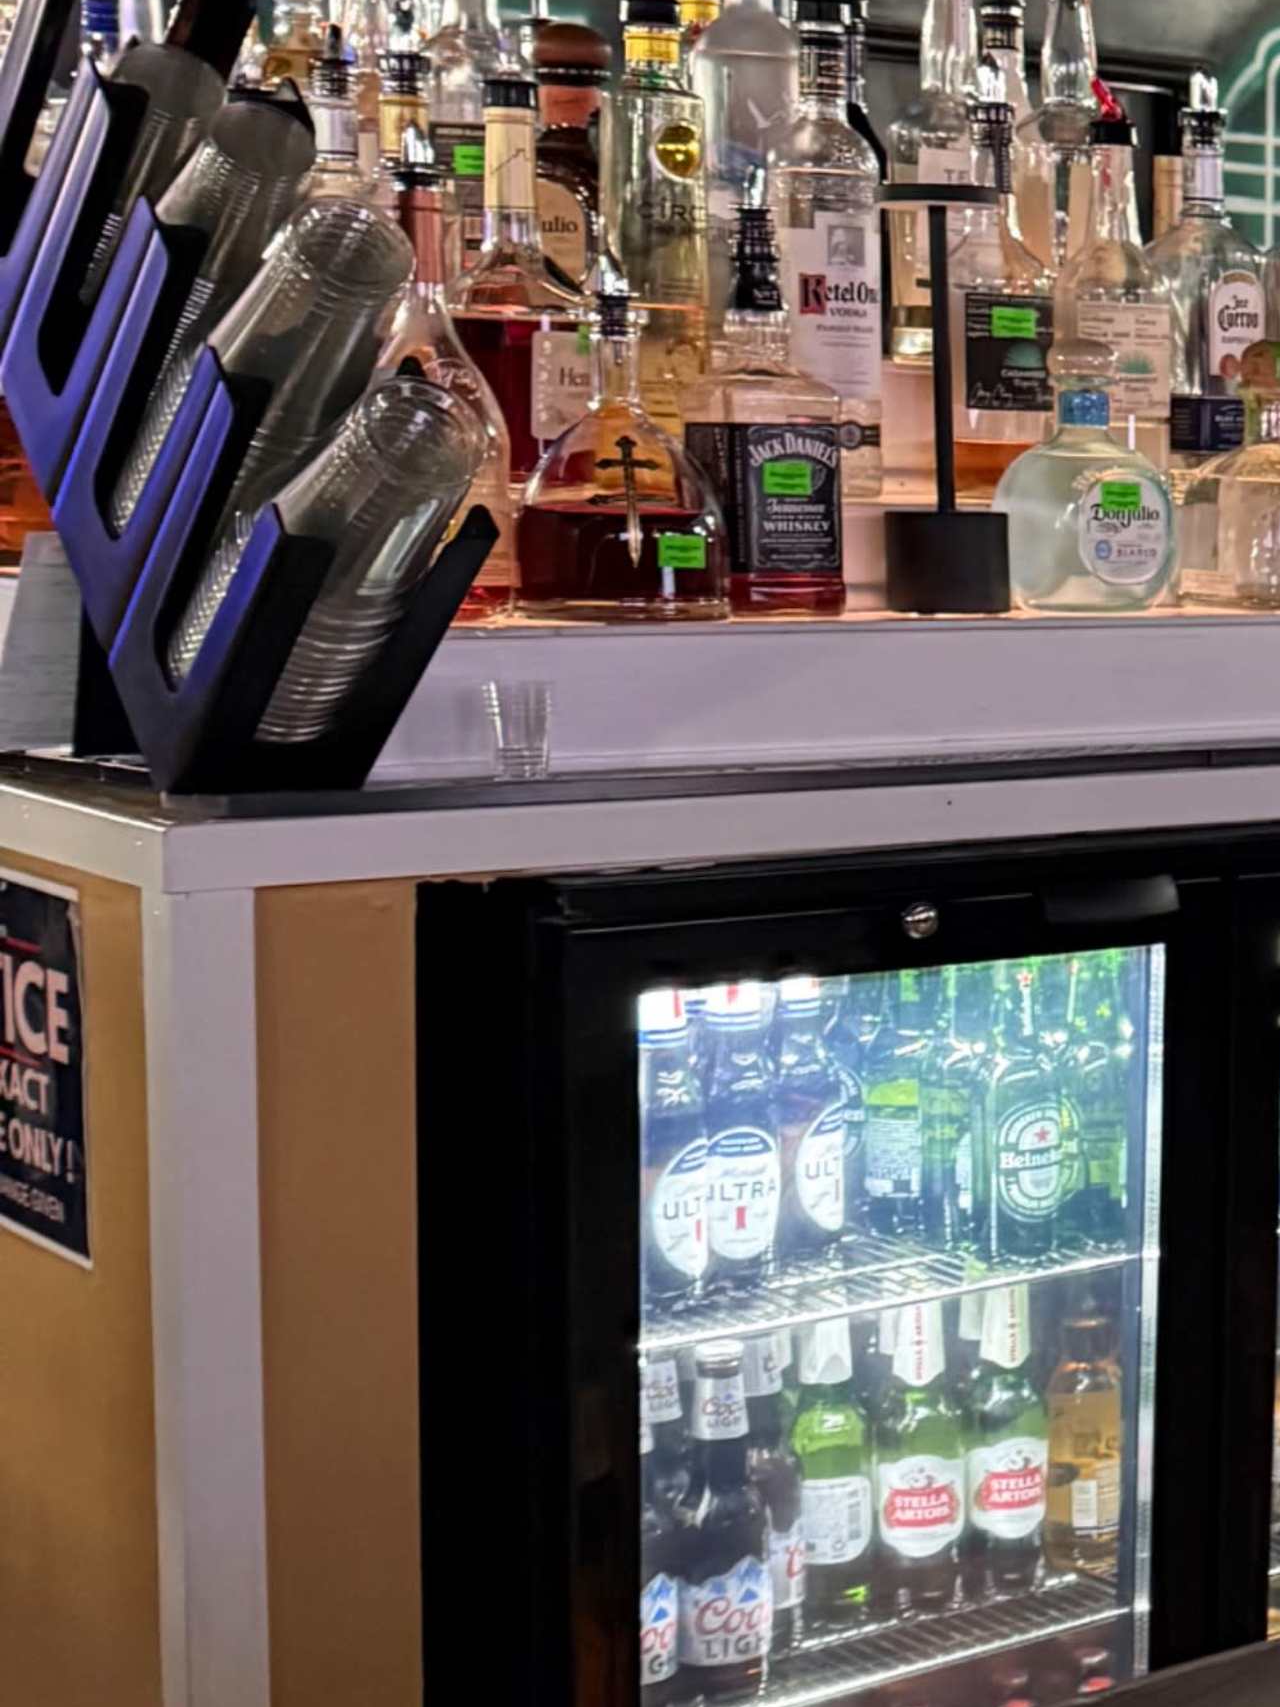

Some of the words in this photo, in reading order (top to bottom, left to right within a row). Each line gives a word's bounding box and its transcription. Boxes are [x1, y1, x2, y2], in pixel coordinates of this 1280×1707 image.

[542, 216, 578, 233] ulio
[801, 276, 855, 308] Ketel
[1217, 304, 1259, 332] Cuervo
[748, 438, 785, 468] JACK
[762, 520, 830, 532] WHISKEY
[0, 952, 69, 1065] ICE
[990, 1474, 1042, 1490] STELLA
[893, 1492, 949, 1509] STELLA
[988, 1487, 1042, 1503] ARTOIS
[891, 1506, 951, 1521] ARTOIS
[695, 1597, 769, 1635] Coo
[705, 1632, 764, 1658] LIG
